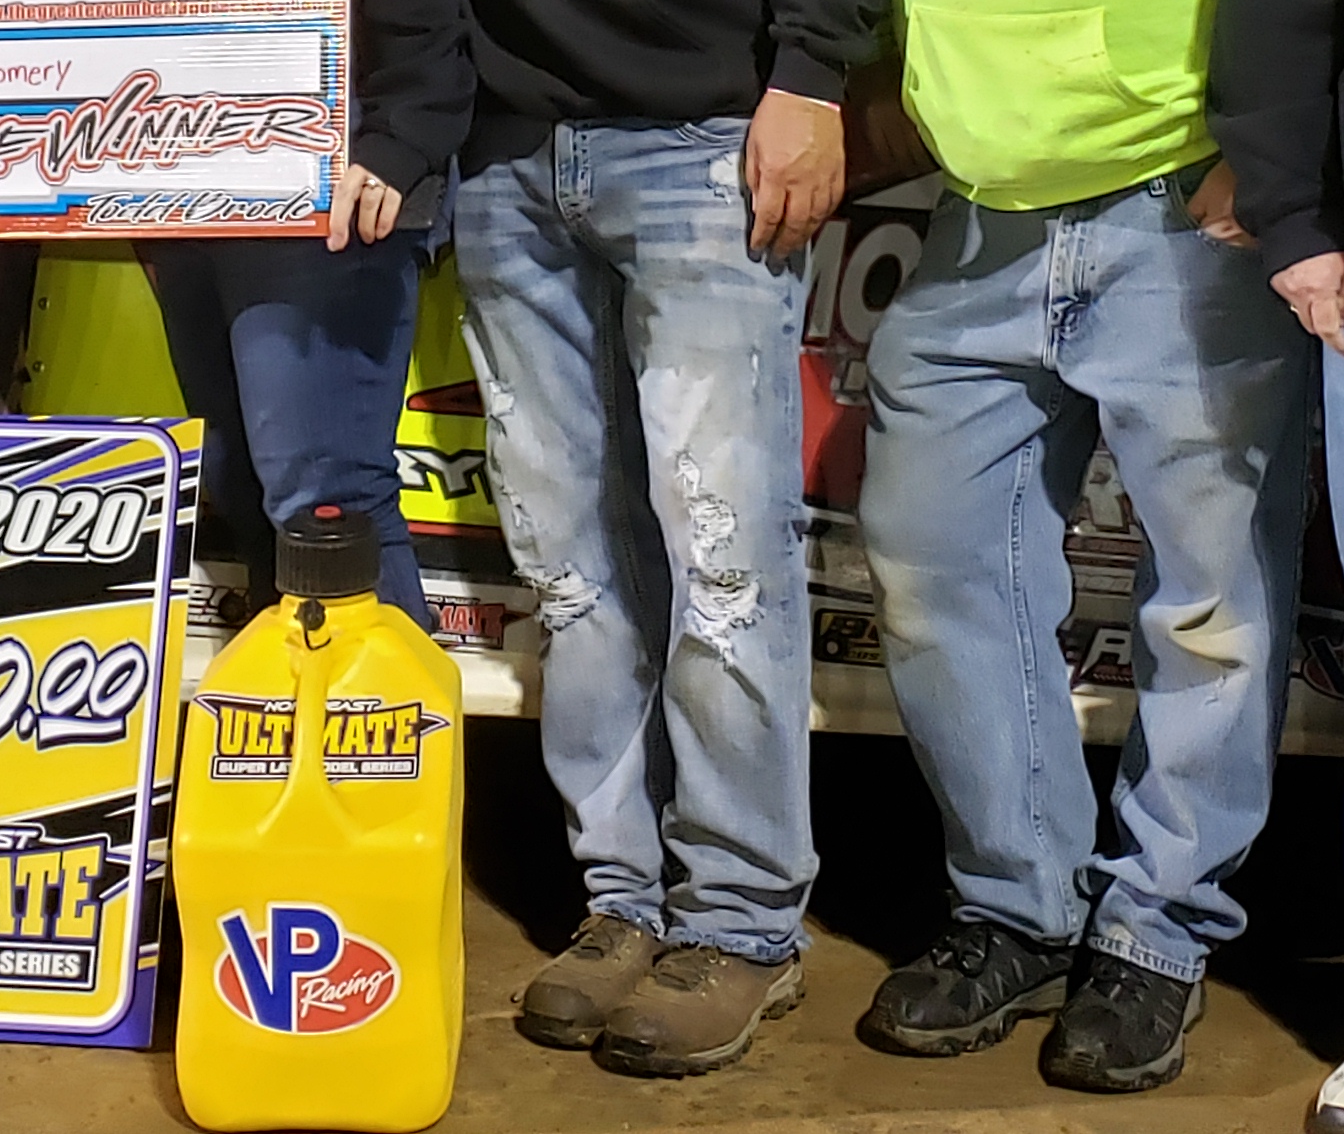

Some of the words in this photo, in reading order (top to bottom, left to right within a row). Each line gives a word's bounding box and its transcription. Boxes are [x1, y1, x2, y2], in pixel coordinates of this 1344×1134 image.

[40, 71, 342, 182] WINNER
[218, 704, 421, 757] ULTMATE
[264, 699, 382, 713] NOEAST
[218, 760, 267, 774] SUPER
[324, 760, 358, 774] ODEL
[216, 902, 344, 1032] VP
[300, 967, 397, 1018] Racing
